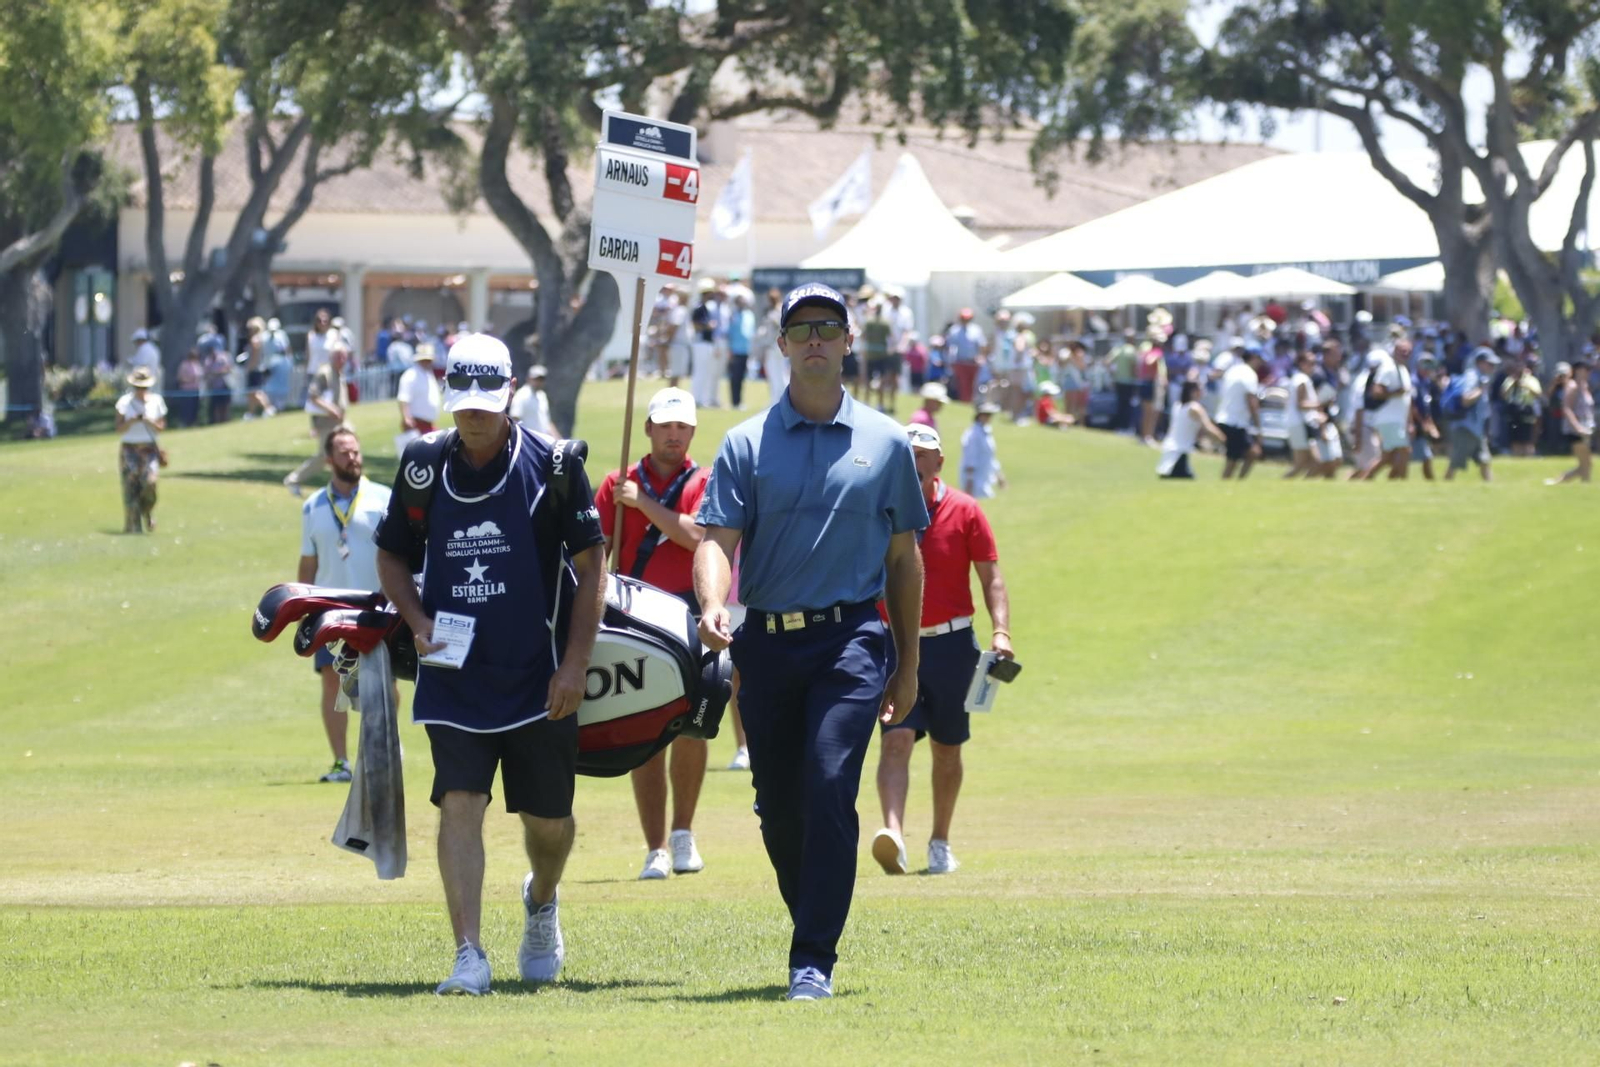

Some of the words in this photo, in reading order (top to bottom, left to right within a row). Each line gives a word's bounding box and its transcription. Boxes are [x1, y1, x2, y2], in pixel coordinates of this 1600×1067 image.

[605, 158, 649, 187] ARNAUS
[667, 170, 698, 201] -4
[599, 236, 639, 263] GARCIA
[660, 245, 691, 276] -4
[787, 286, 840, 310] SRIXON
[453, 362, 500, 376] SRIXON
[447, 541, 478, 550] ESTRELLA
[478, 539, 500, 547] DAMM
[482, 545, 511, 555] MASTERS
[452, 582, 506, 598] ESTRELLA
[467, 596, 488, 604] DAMM
[692, 697, 709, 728] SRIXON
